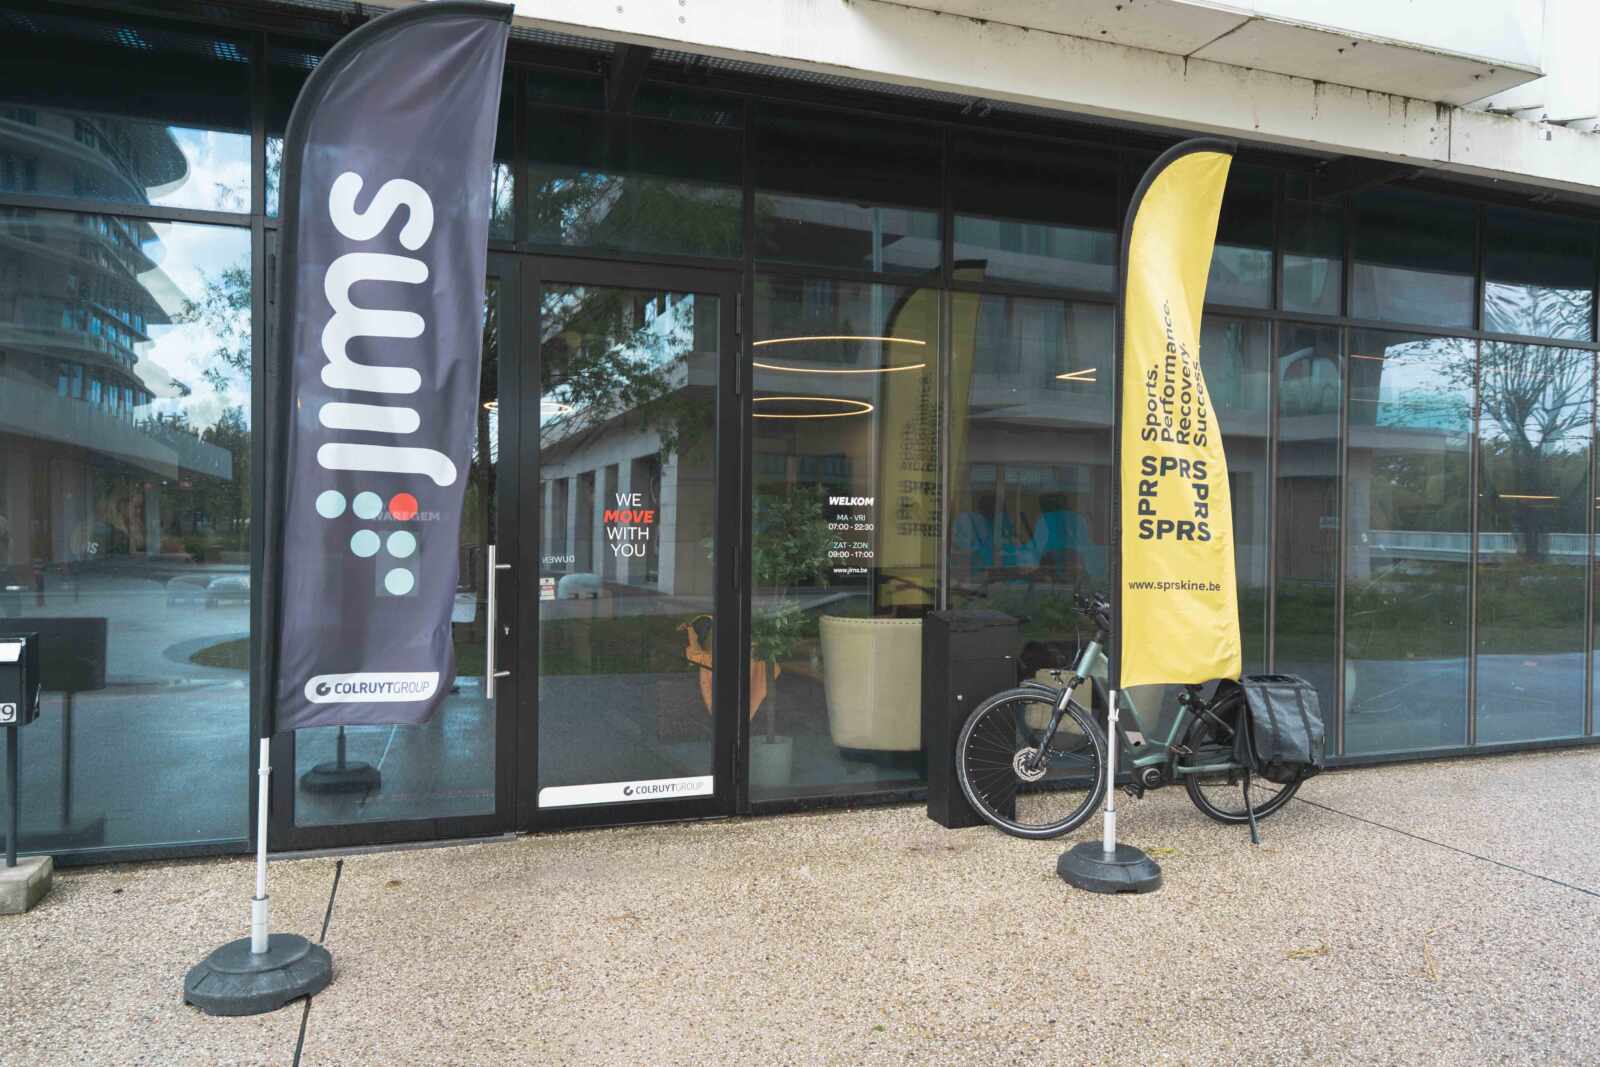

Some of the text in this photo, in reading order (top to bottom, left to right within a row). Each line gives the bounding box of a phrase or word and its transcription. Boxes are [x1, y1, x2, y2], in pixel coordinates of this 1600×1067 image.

[1159, 300, 1177, 442] Performance.
[1176, 343, 1192, 445] Recovery.
[1141, 364, 1162, 442] Sports.
[1141, 455, 1208, 480] SPRS
[616, 493, 642, 507] WE
[829, 496, 874, 506] WELKOM
[604, 510, 656, 523] MOVE
[607, 526, 649, 541] WITH
[828, 523, 849, 531] 07:00
[1138, 519, 1211, 541] SPRS
[610, 543, 646, 558] YOU
[1128, 580, 1221, 592] www.sprskine.be
